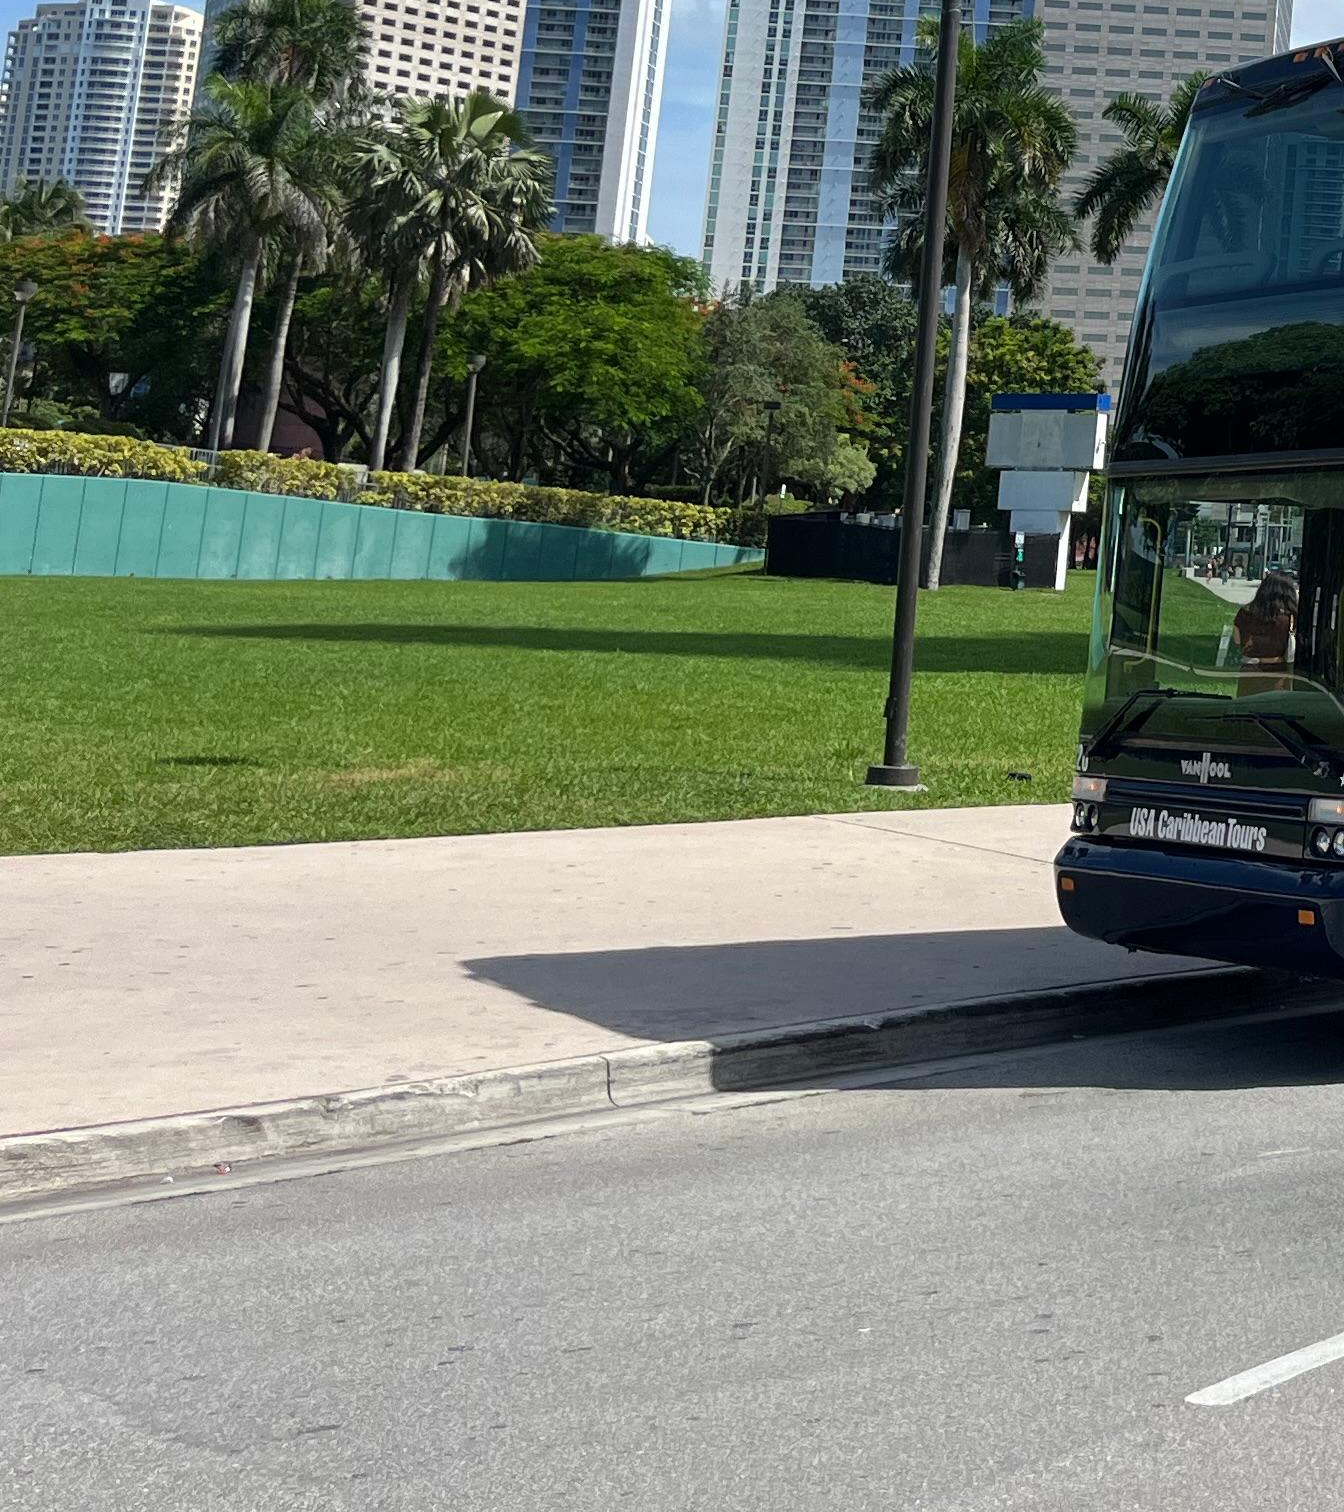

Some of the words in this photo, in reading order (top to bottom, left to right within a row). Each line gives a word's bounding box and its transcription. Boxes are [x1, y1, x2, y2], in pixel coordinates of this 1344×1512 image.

[1129, 807, 1155, 838] USA
[1157, 809, 1227, 847] Caribbean
[1226, 818, 1267, 852] Tours
